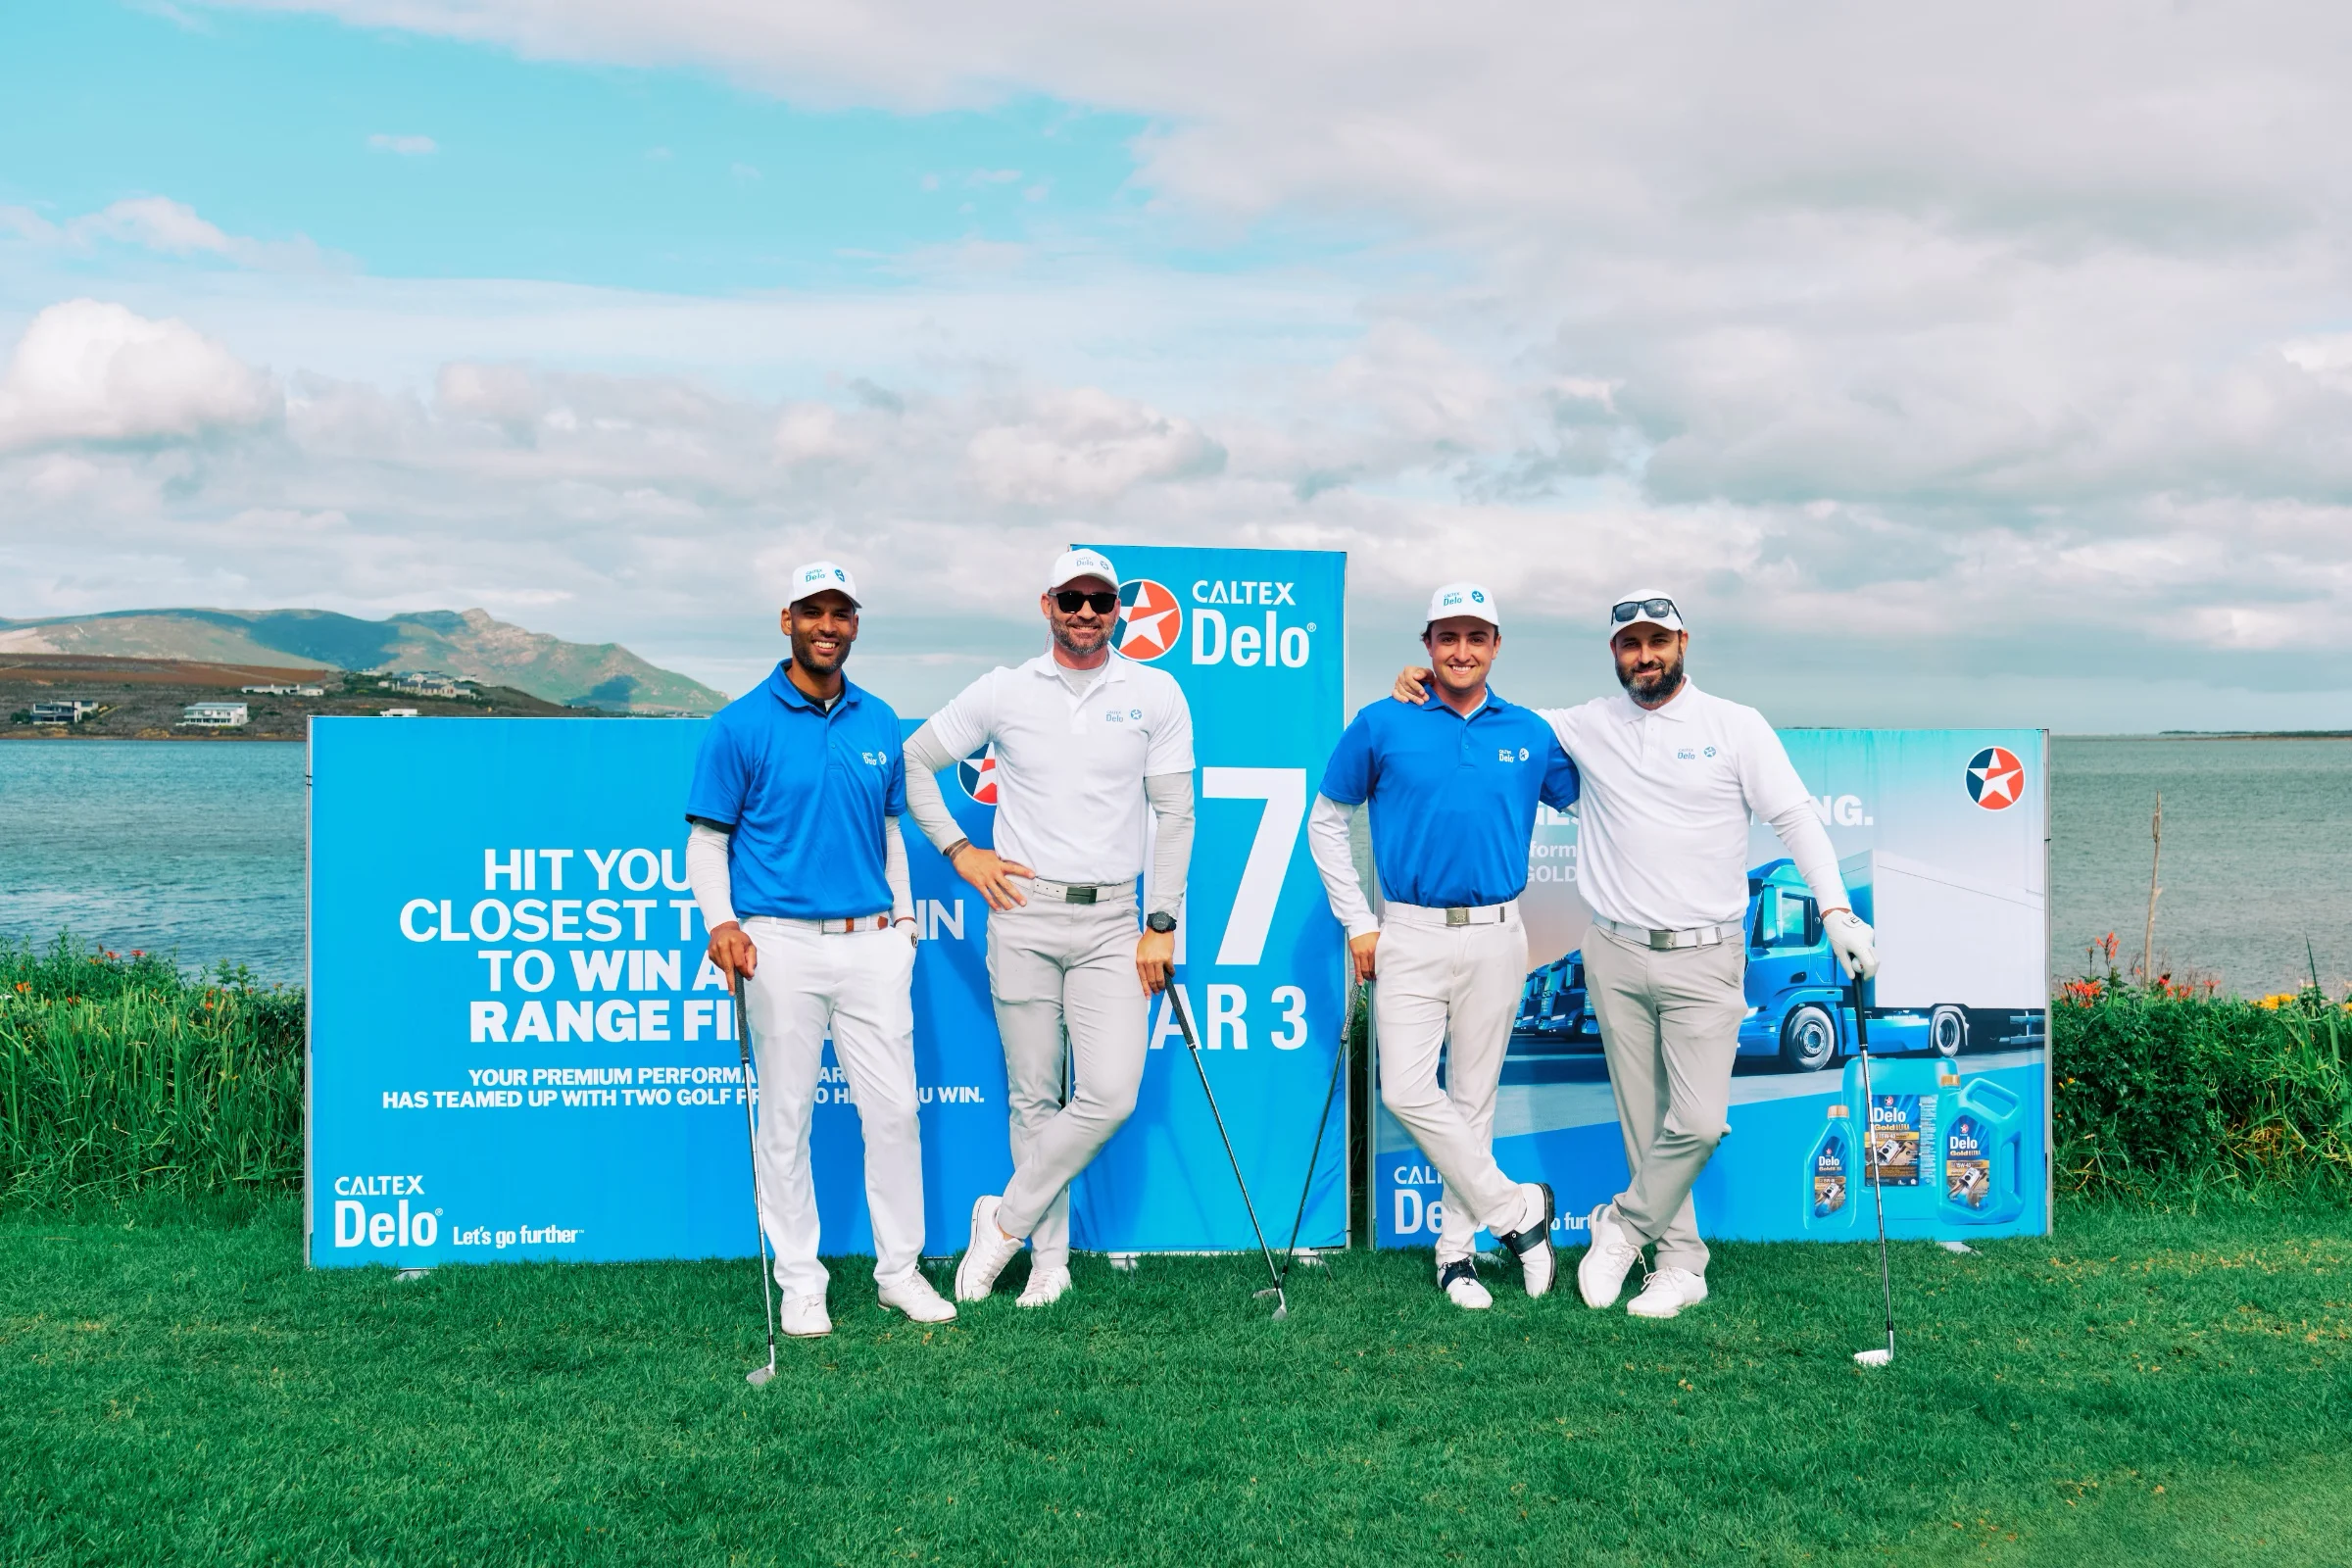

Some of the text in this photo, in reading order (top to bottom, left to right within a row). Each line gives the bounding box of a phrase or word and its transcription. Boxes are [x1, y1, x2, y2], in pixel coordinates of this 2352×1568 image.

[806, 572, 826, 582] Delo
[1192, 579, 1296, 605] CALTEX
[1444, 596, 1463, 606] Delo
[1106, 713, 1124, 722] Delo
[484, 849, 692, 892] HIT YOU
[400, 899, 964, 942] CLOSEST T IN
[478, 950, 555, 992] TO
[569, 950, 680, 992] WIN
[469, 1000, 668, 1042] RANGE
[1148, 984, 1308, 1050] AR 3
[468, 1068, 527, 1086] YOUR
[533, 1067, 631, 1085] PREMIUM
[638, 1067, 758, 1084] PERFORMA
[382, 1091, 428, 1108] HAS
[433, 1090, 522, 1107] TEAMED
[528, 1090, 557, 1107] UP
[562, 1089, 615, 1106] WITH
[621, 1089, 671, 1105] TWO
[676, 1088, 731, 1105] GOLF
[938, 1086, 985, 1103] WIN.
[1874, 1107, 1906, 1123] Delo
[1949, 1136, 1978, 1150] Delo
[1818, 1155, 1840, 1166] Delo
[334, 1175, 425, 1197] CALTEX
[453, 1226, 491, 1246] Let's
[496, 1230, 516, 1250] go
